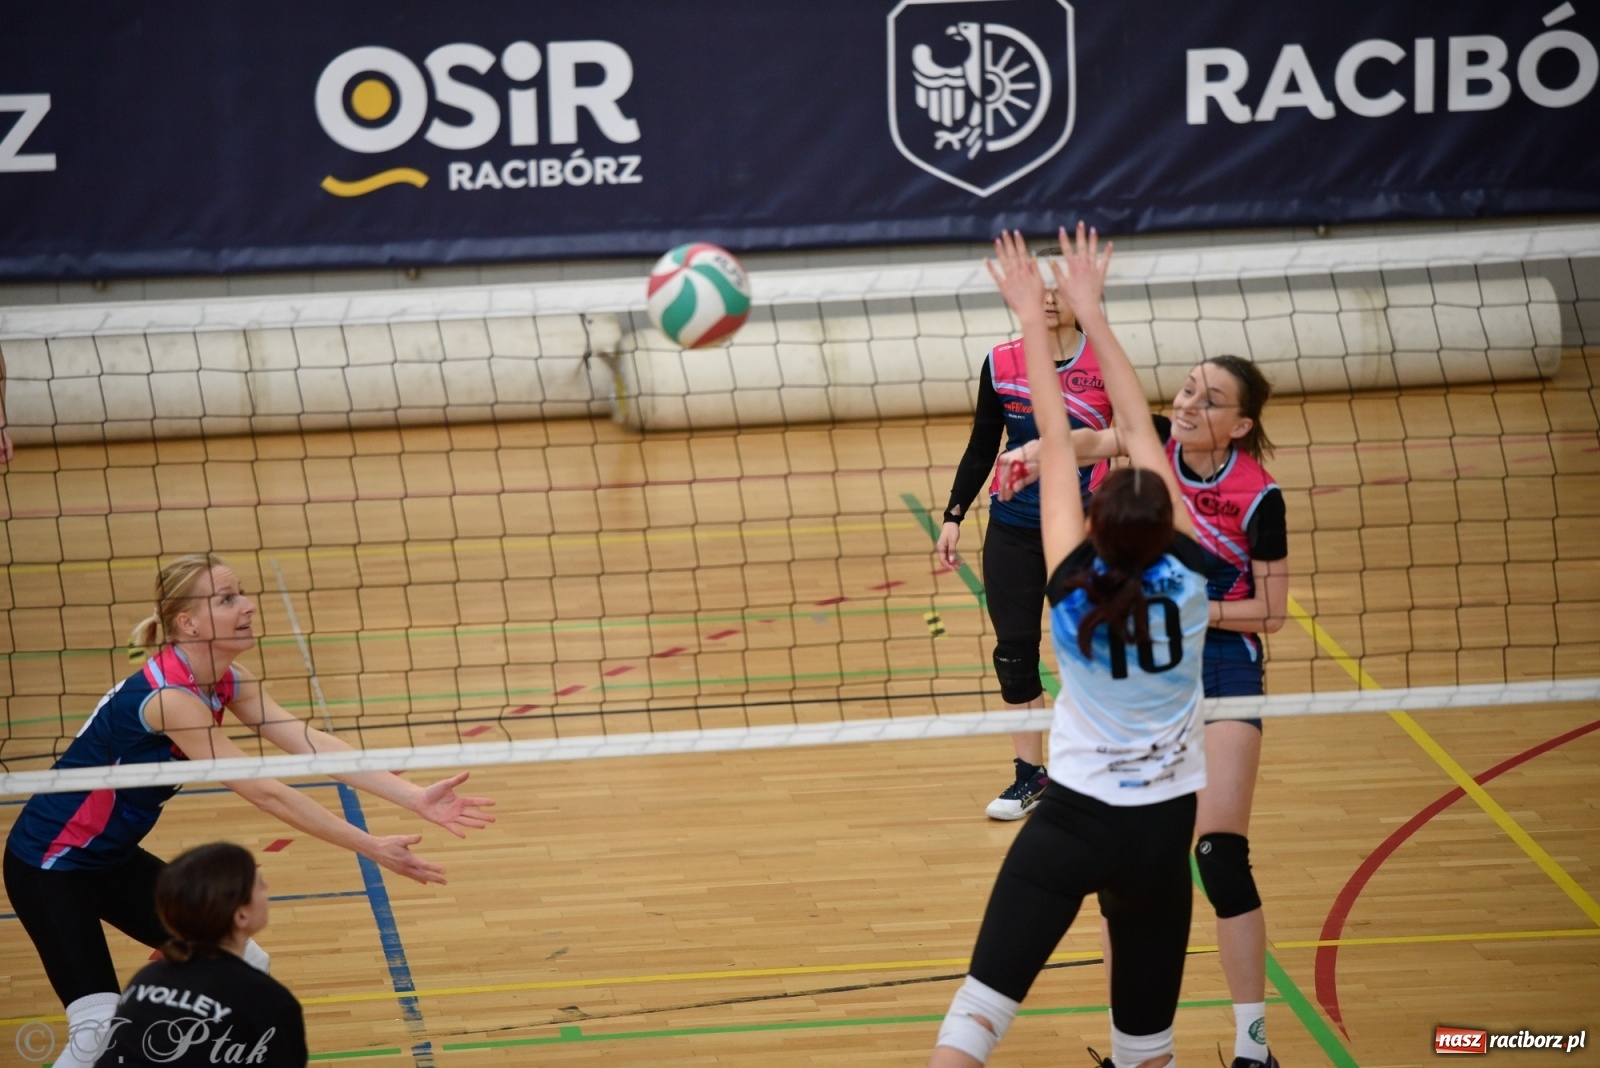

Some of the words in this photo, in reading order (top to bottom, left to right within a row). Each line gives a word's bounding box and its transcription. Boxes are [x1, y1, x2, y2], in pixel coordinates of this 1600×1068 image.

[1186, 2, 1599, 125] RACIBÓ
[448, 149, 642, 191] RACIBÓRZ
[136, 984, 232, 1023] VOLLEY
